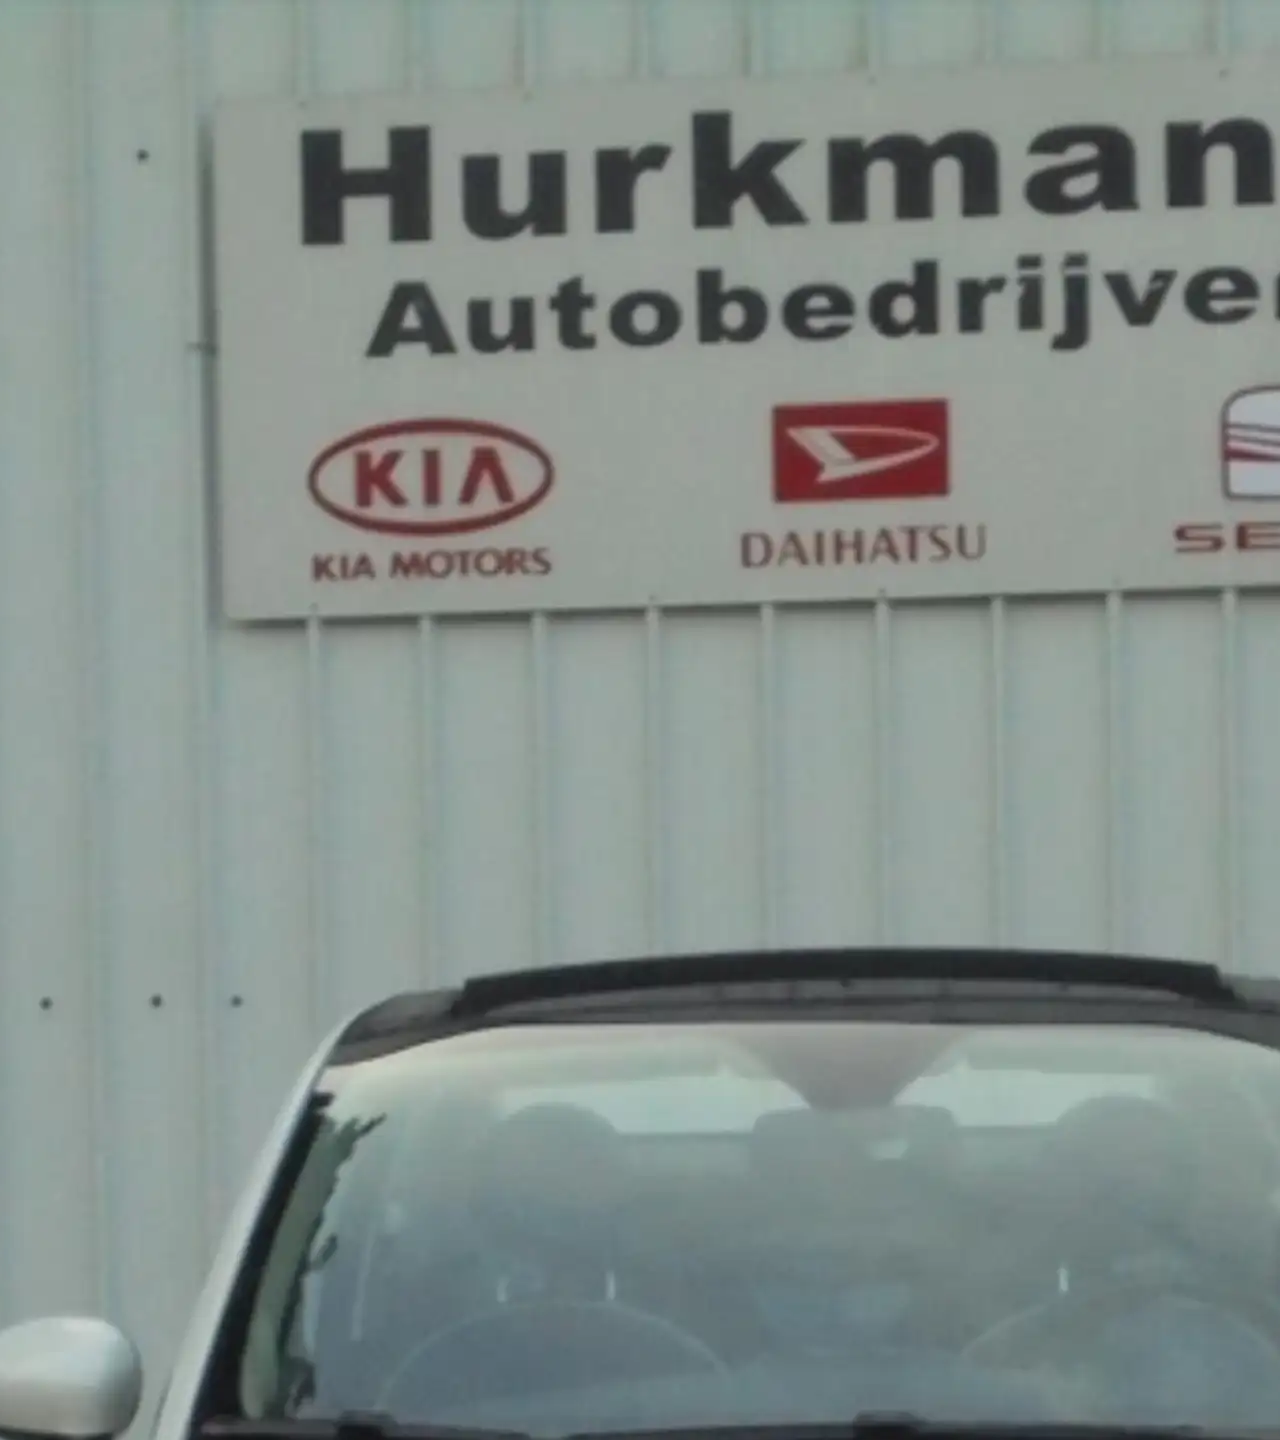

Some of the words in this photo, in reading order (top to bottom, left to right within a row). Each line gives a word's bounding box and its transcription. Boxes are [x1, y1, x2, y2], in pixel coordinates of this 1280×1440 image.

[352, 448, 516, 508] KIA
[312, 553, 377, 582] KIA
[388, 546, 553, 580] MOTORS
[740, 525, 988, 570] DAIHATSU
